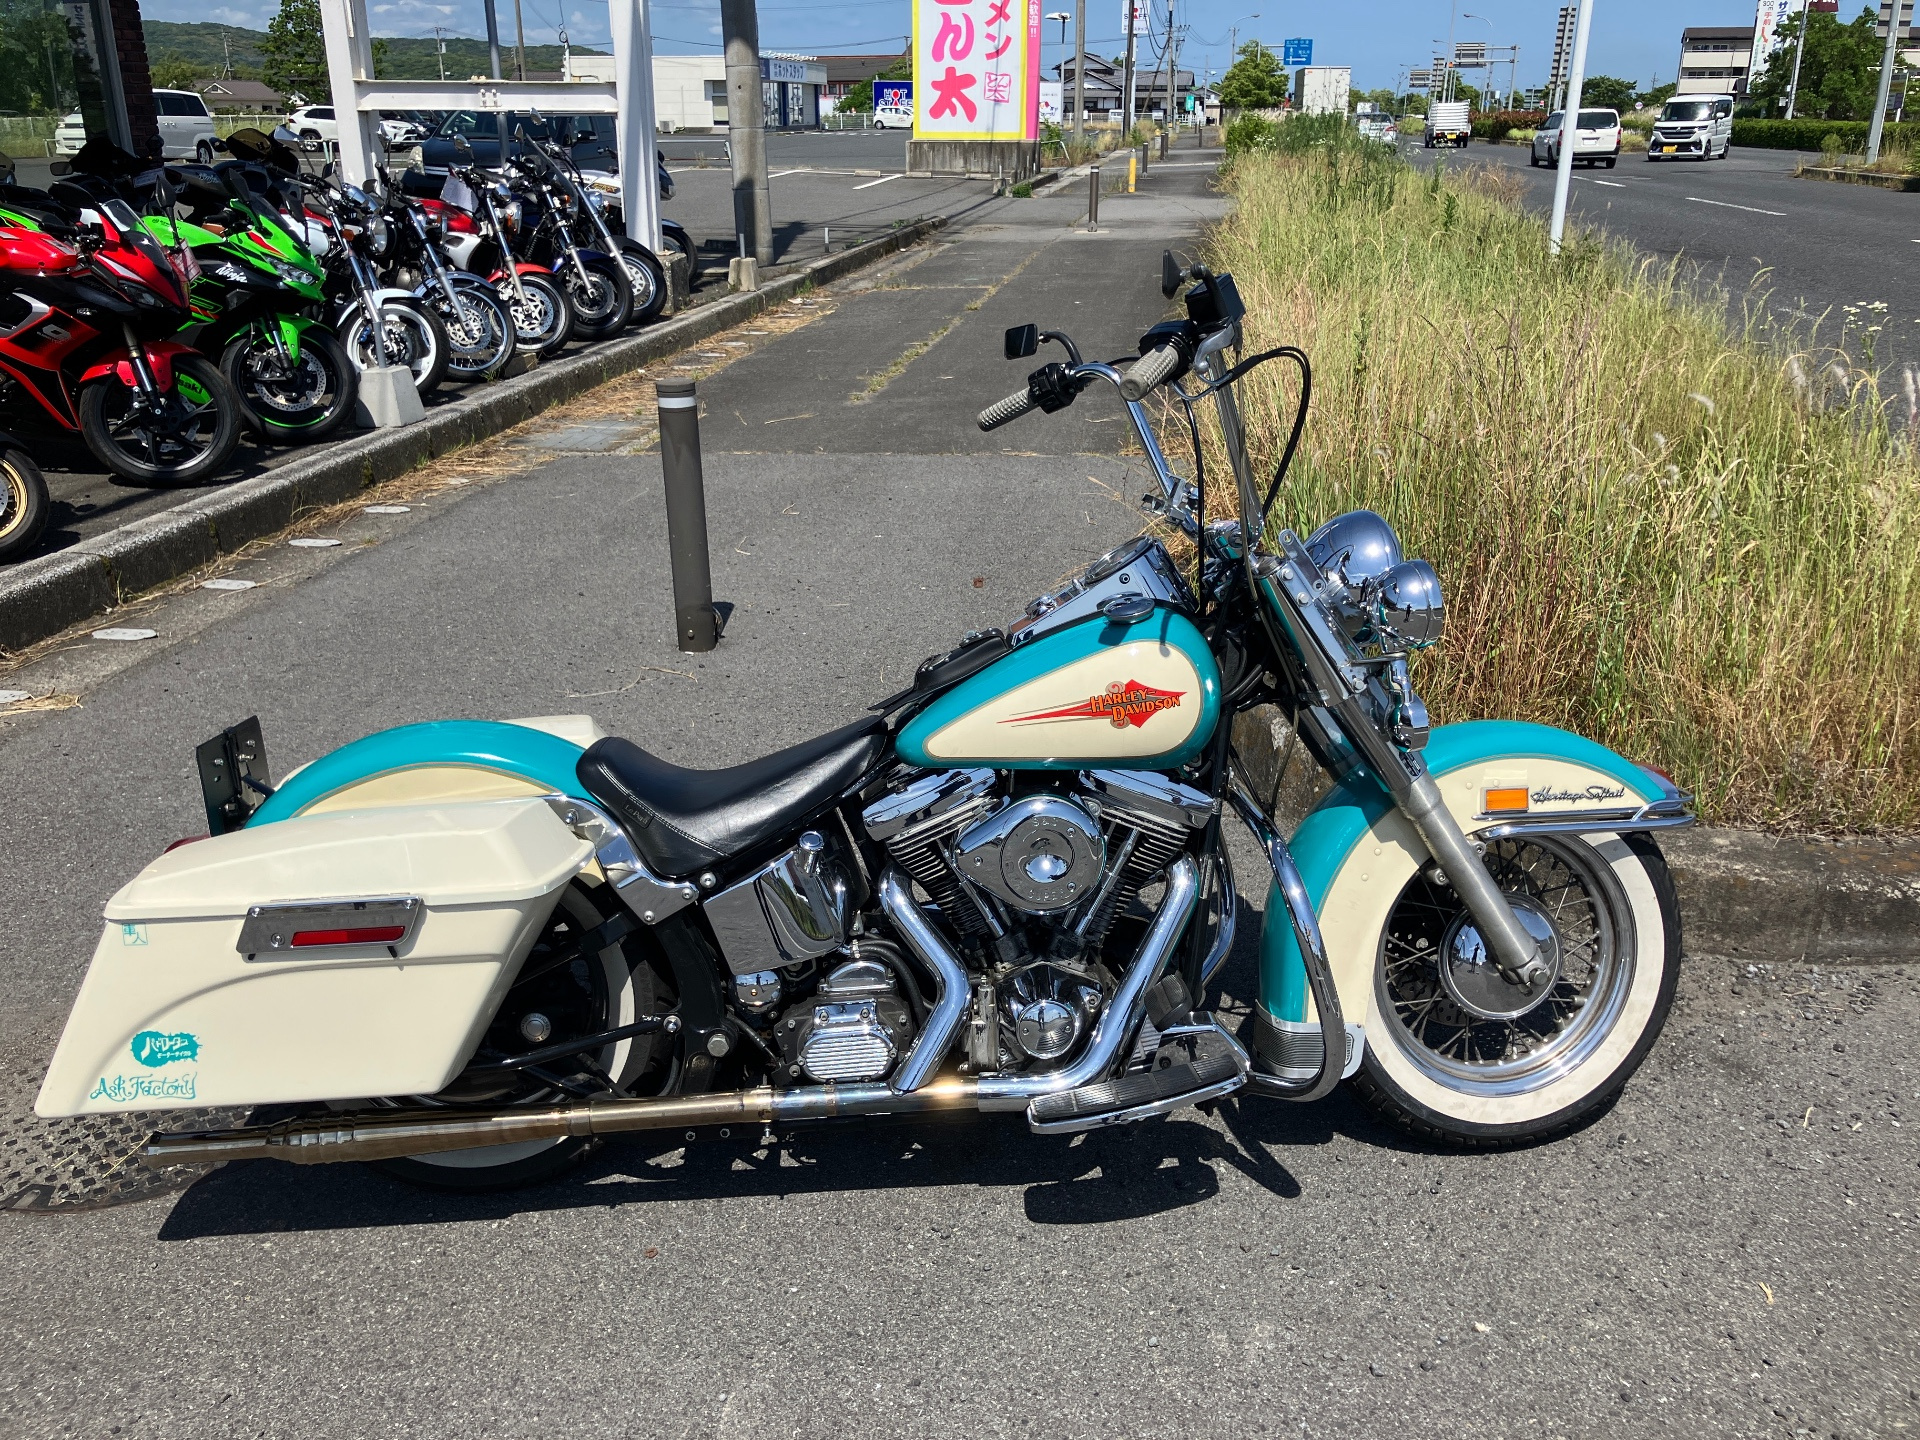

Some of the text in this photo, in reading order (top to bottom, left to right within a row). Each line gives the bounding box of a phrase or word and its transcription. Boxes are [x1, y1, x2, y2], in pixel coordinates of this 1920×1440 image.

[929, 0, 977, 122] ん太
[214, 265, 248, 283] Ninja
[1090, 688, 1157, 713] HARLEY-
[1111, 695, 1181, 722] DAVIDSON
[1530, 785, 1625, 804] Heritage Softail
[89, 1071, 198, 1103] Ash Factory
